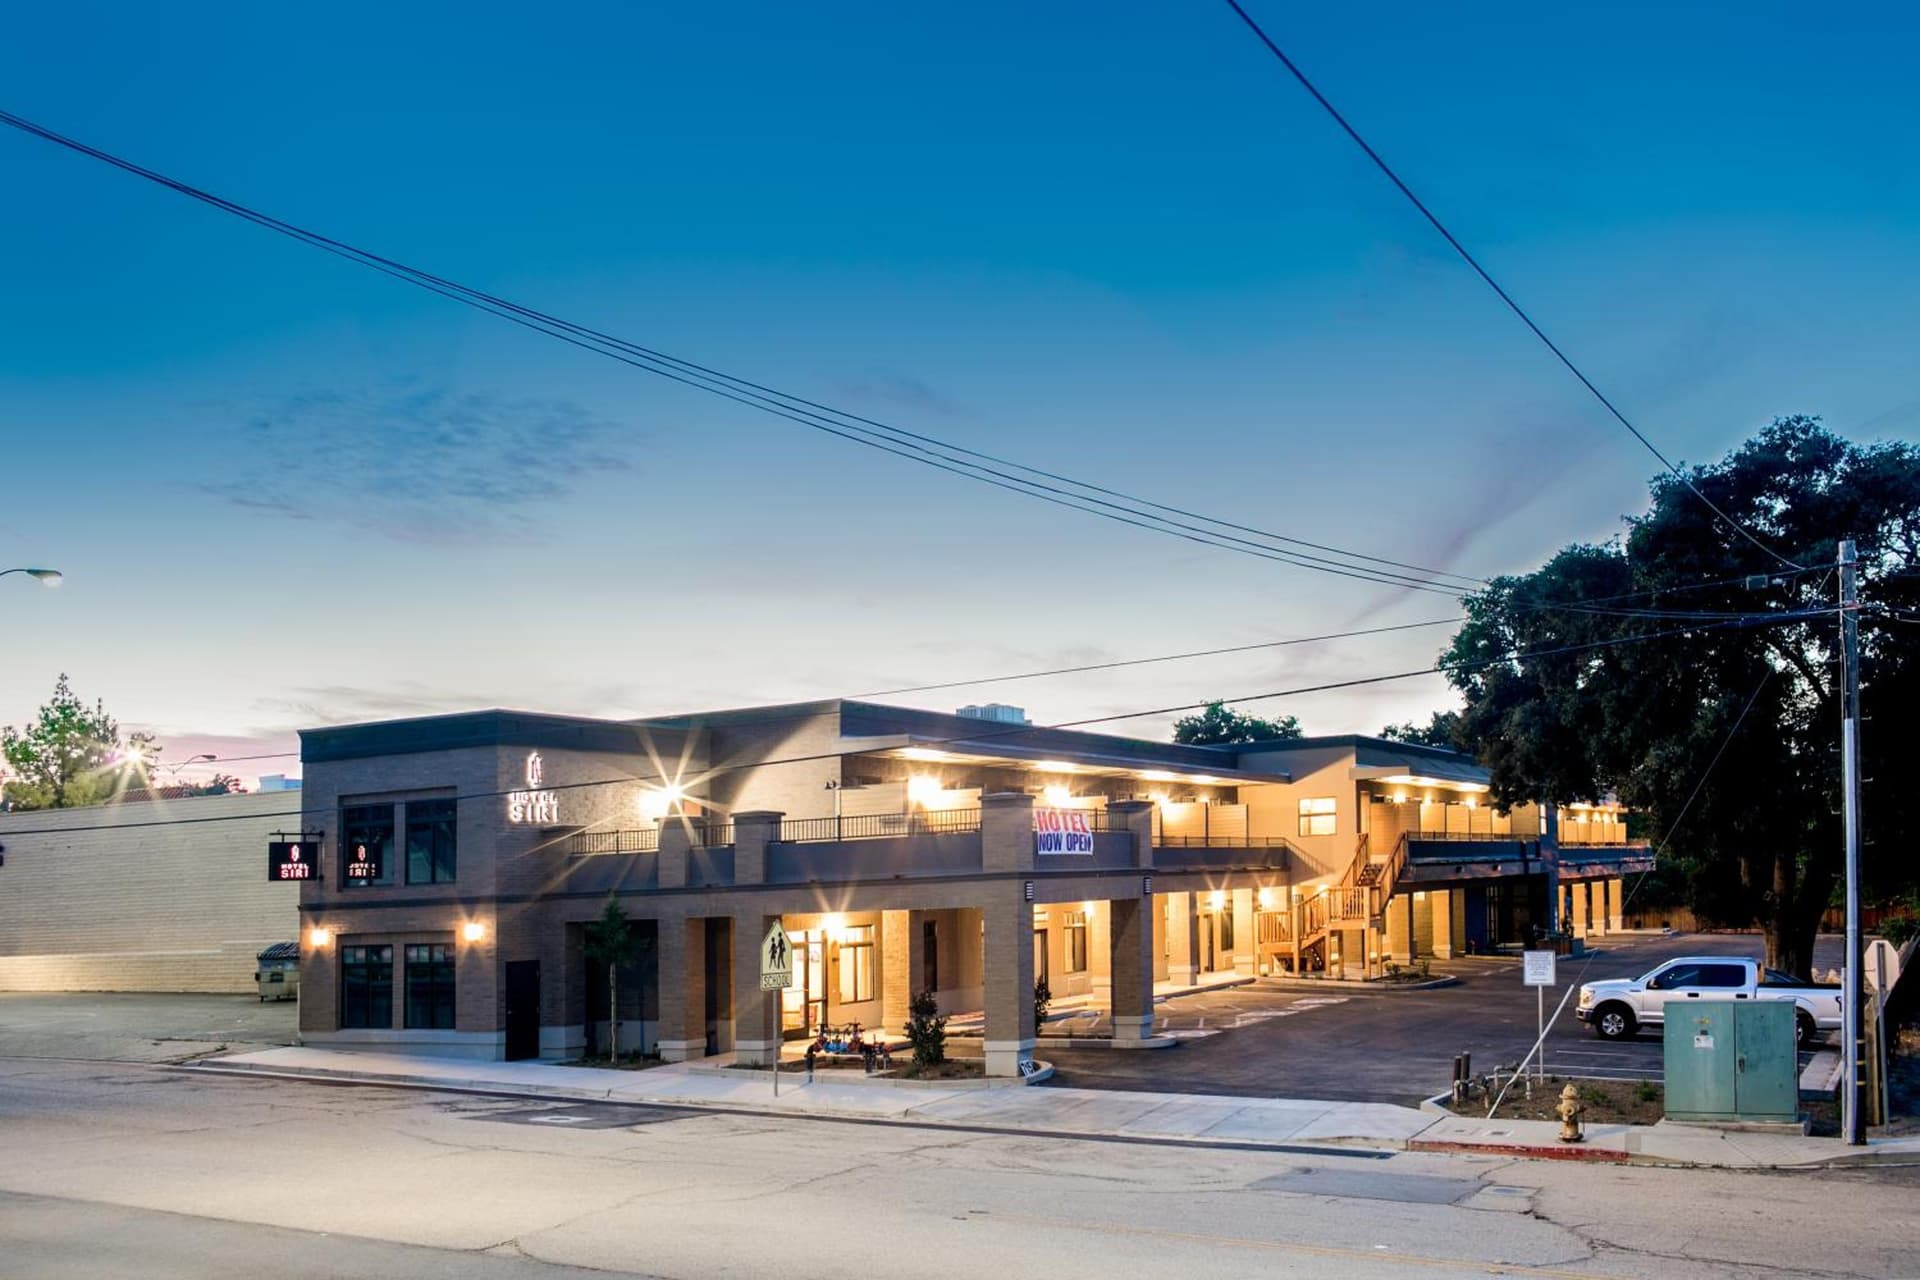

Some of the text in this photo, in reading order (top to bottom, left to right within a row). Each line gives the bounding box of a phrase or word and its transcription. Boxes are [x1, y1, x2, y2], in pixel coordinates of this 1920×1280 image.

[509, 803, 560, 823] SIRI
[1036, 810, 1089, 832] HOTEL
[1039, 832, 1091, 852] NOW OPEN
[281, 869, 309, 879] SIRI
[763, 974, 791, 987] SCHOOL
